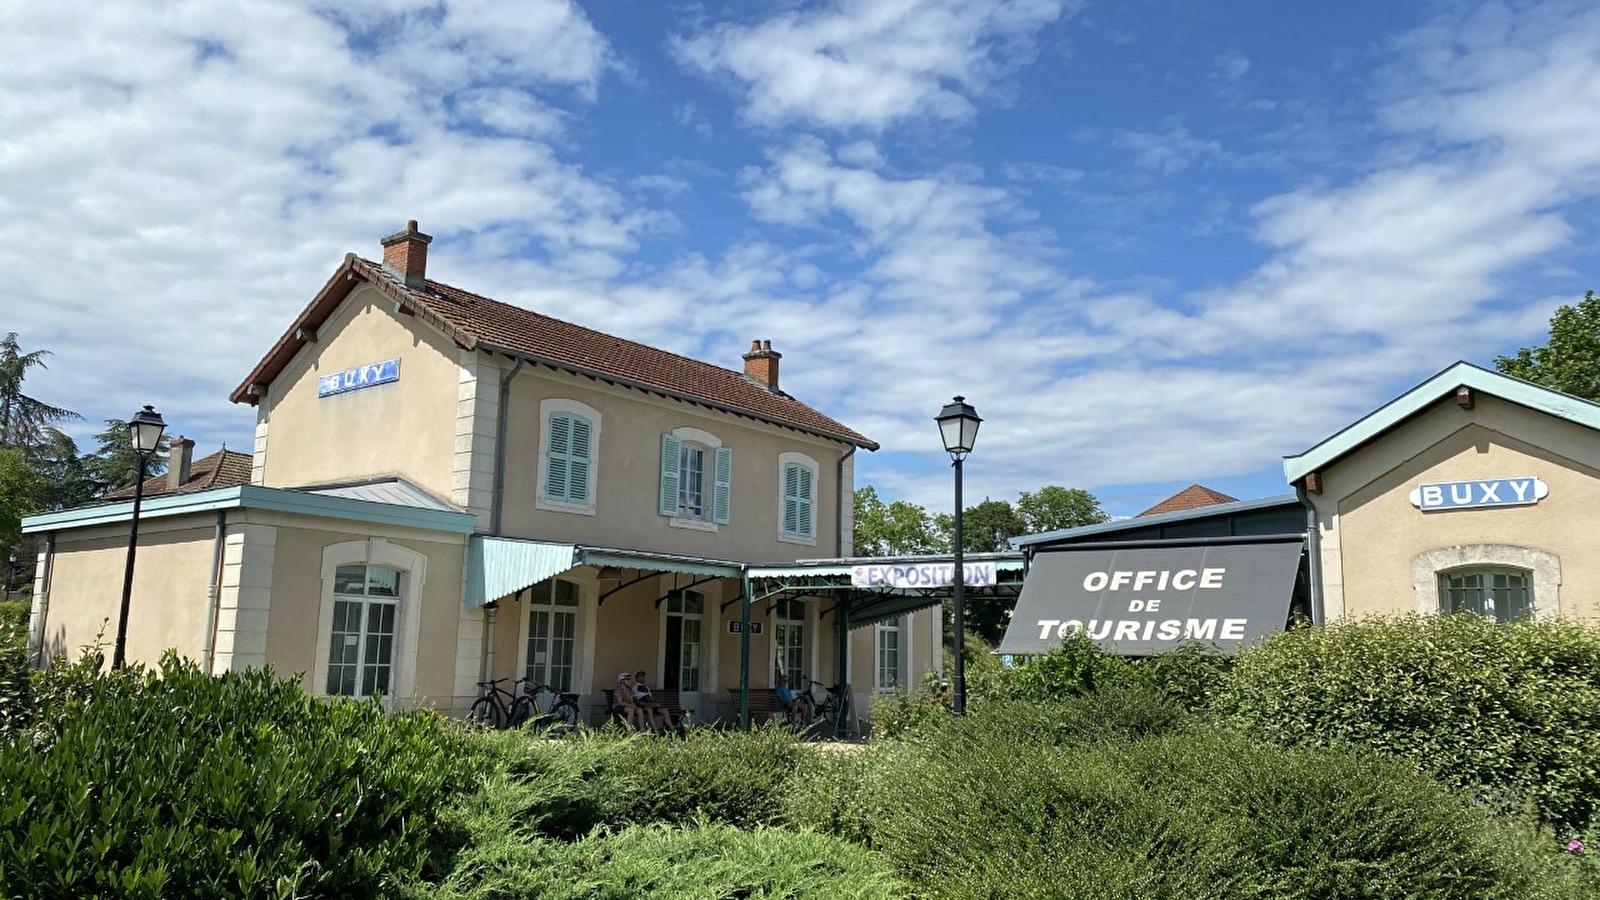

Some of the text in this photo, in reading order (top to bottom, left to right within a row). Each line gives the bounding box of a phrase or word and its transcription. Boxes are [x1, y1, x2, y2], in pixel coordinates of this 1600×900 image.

[330, 365, 384, 389] BUXY
[1423, 481, 1529, 505] BUXY
[1083, 568, 1226, 592] OFFICE
[1128, 599, 1161, 613] DE
[733, 622, 758, 632] BY
[1037, 618, 1248, 641] TOURISME
